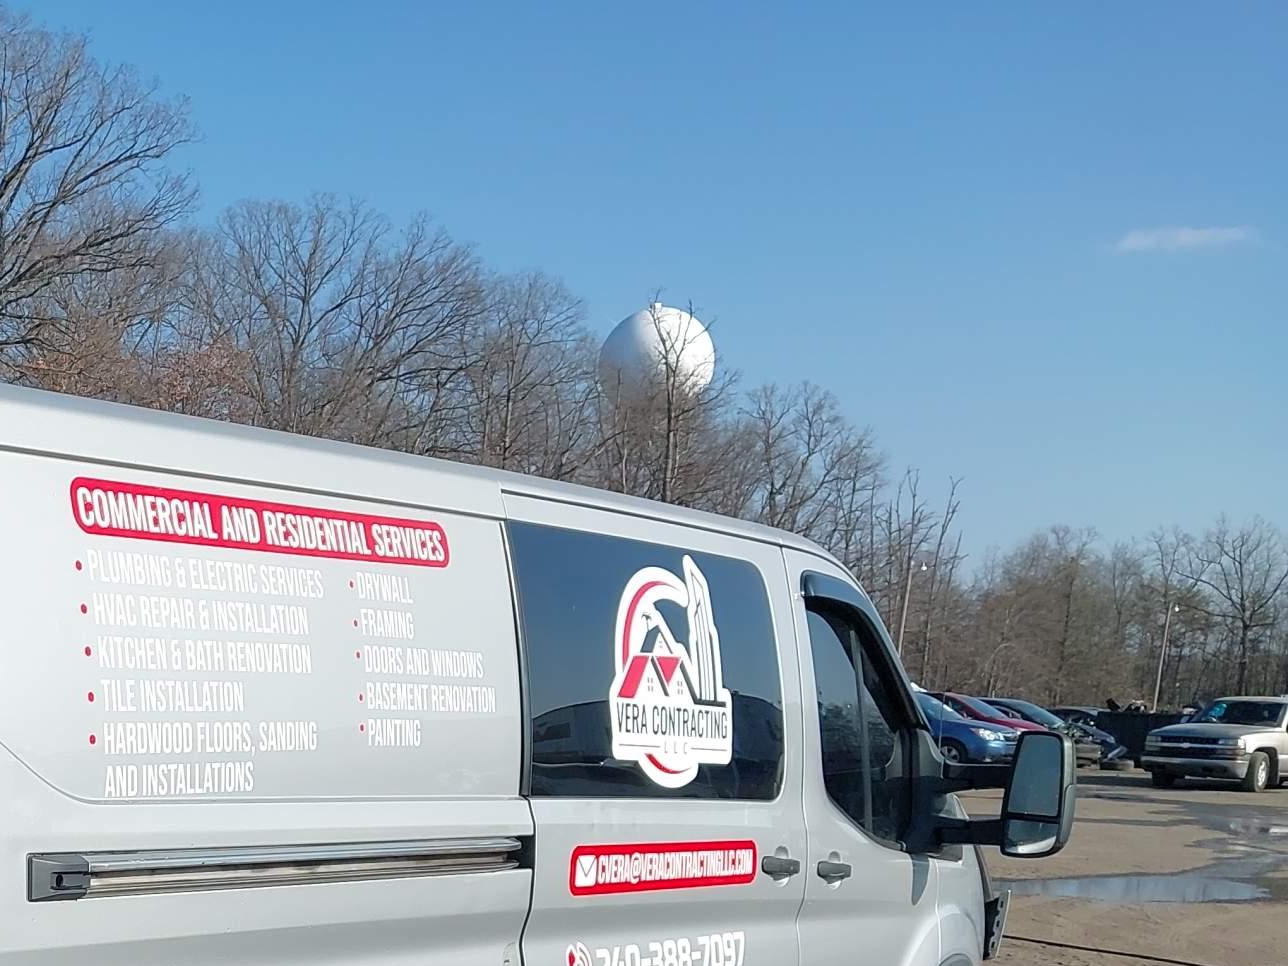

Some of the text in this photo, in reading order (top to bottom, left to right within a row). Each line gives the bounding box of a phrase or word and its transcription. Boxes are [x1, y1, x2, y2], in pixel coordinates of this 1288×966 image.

[76, 486, 446, 563] COMMERCIAL AND RESIDENTIAL SERVICES
[86, 549, 324, 599] PLUMBING & ELECTRIC SERVICES
[355, 572, 413, 604] DRYWALL
[92, 594, 310, 636] HVAC REPAIR & INSTALLATION
[360, 608, 415, 640] FRAMING
[97, 635, 312, 674] KITCHEN & BATH RENOVATION
[364, 645, 485, 679] DOORS AND WINDOWS
[101, 679, 245, 712] TILE INSTALLATION
[366, 682, 496, 713] BASEMENT RENOVATION
[367, 718, 421, 748] PAINTING
[616, 702, 728, 739] VERA CONTRACTING
[103, 721, 318, 756] HARDWOOD FLOORS, SANDING
[104, 761, 255, 797] AND INSTALLATIONS
[598, 849, 754, 885] CVERA@VERACONTRACTINGLLC.COM
